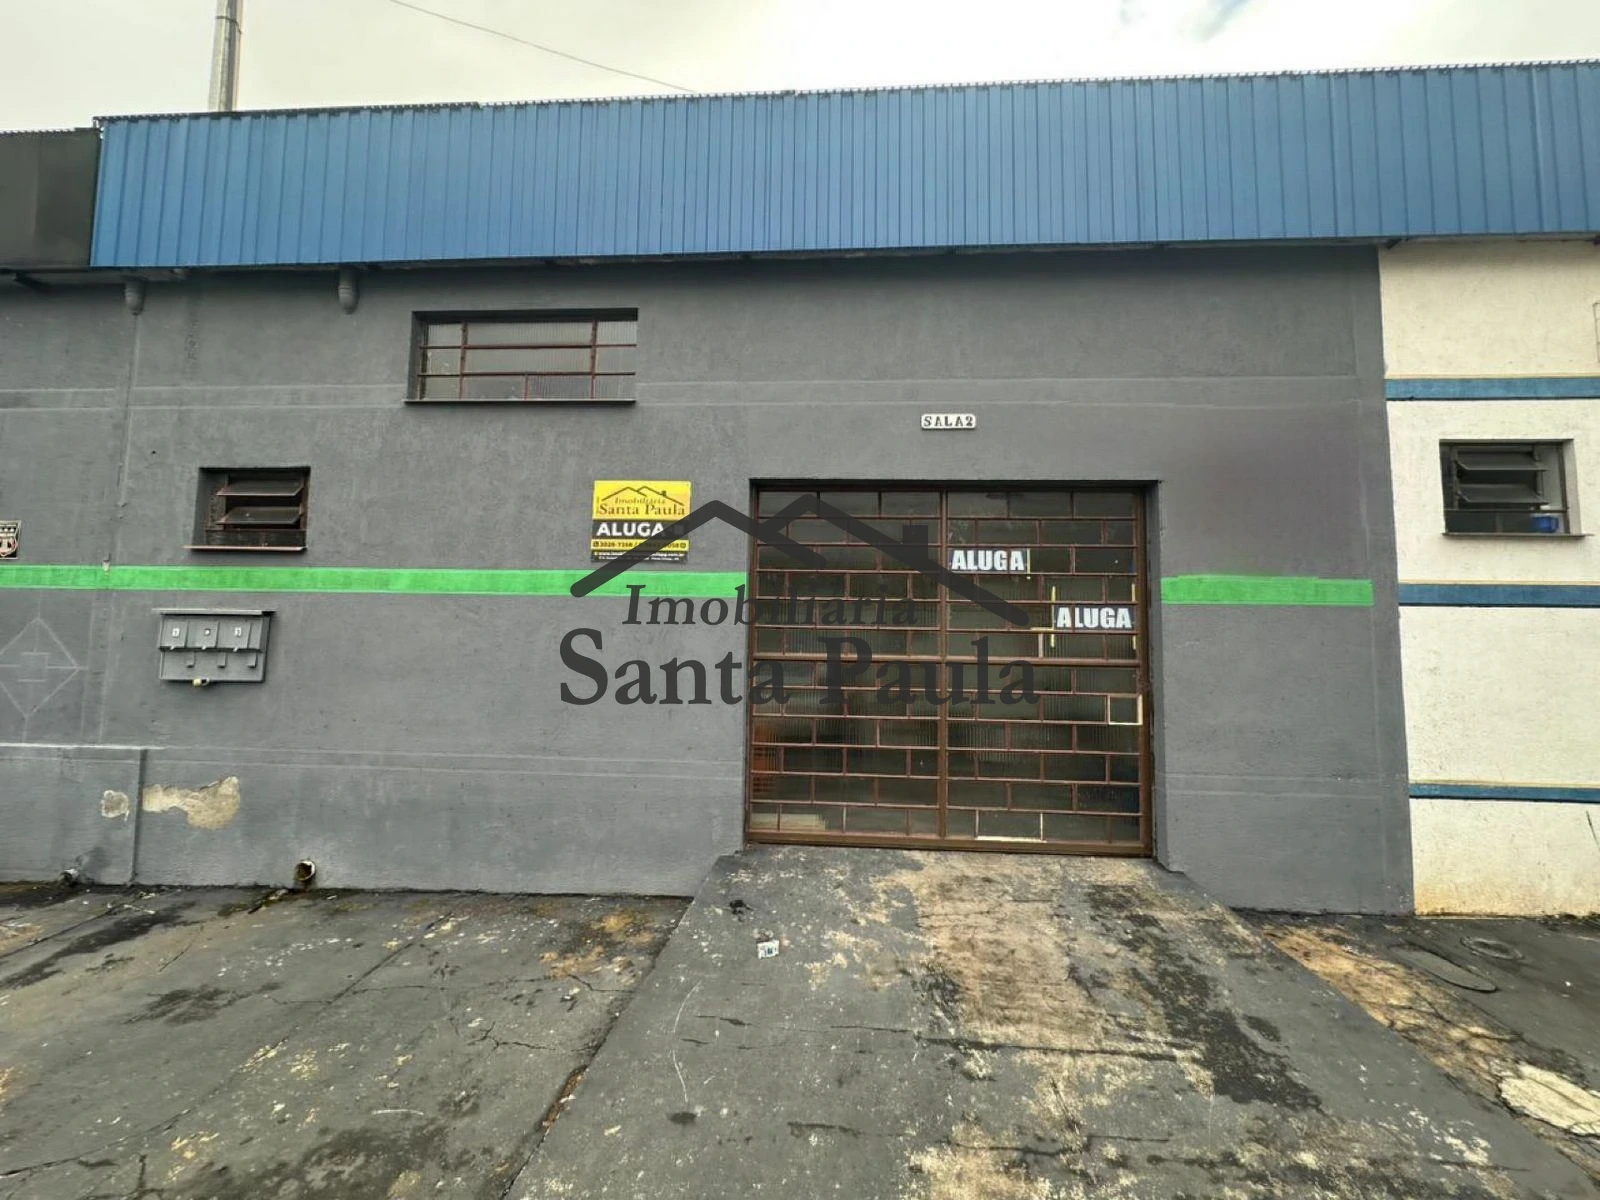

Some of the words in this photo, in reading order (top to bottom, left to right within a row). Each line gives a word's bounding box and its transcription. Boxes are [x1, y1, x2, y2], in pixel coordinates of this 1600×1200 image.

[600, 503, 639, 515] Santa
[645, 503, 685, 515] Paula
[596, 522, 665, 537] ALUGA
[951, 550, 1025, 571] ALUGA
[1056, 607, 1132, 628] ALUGA
